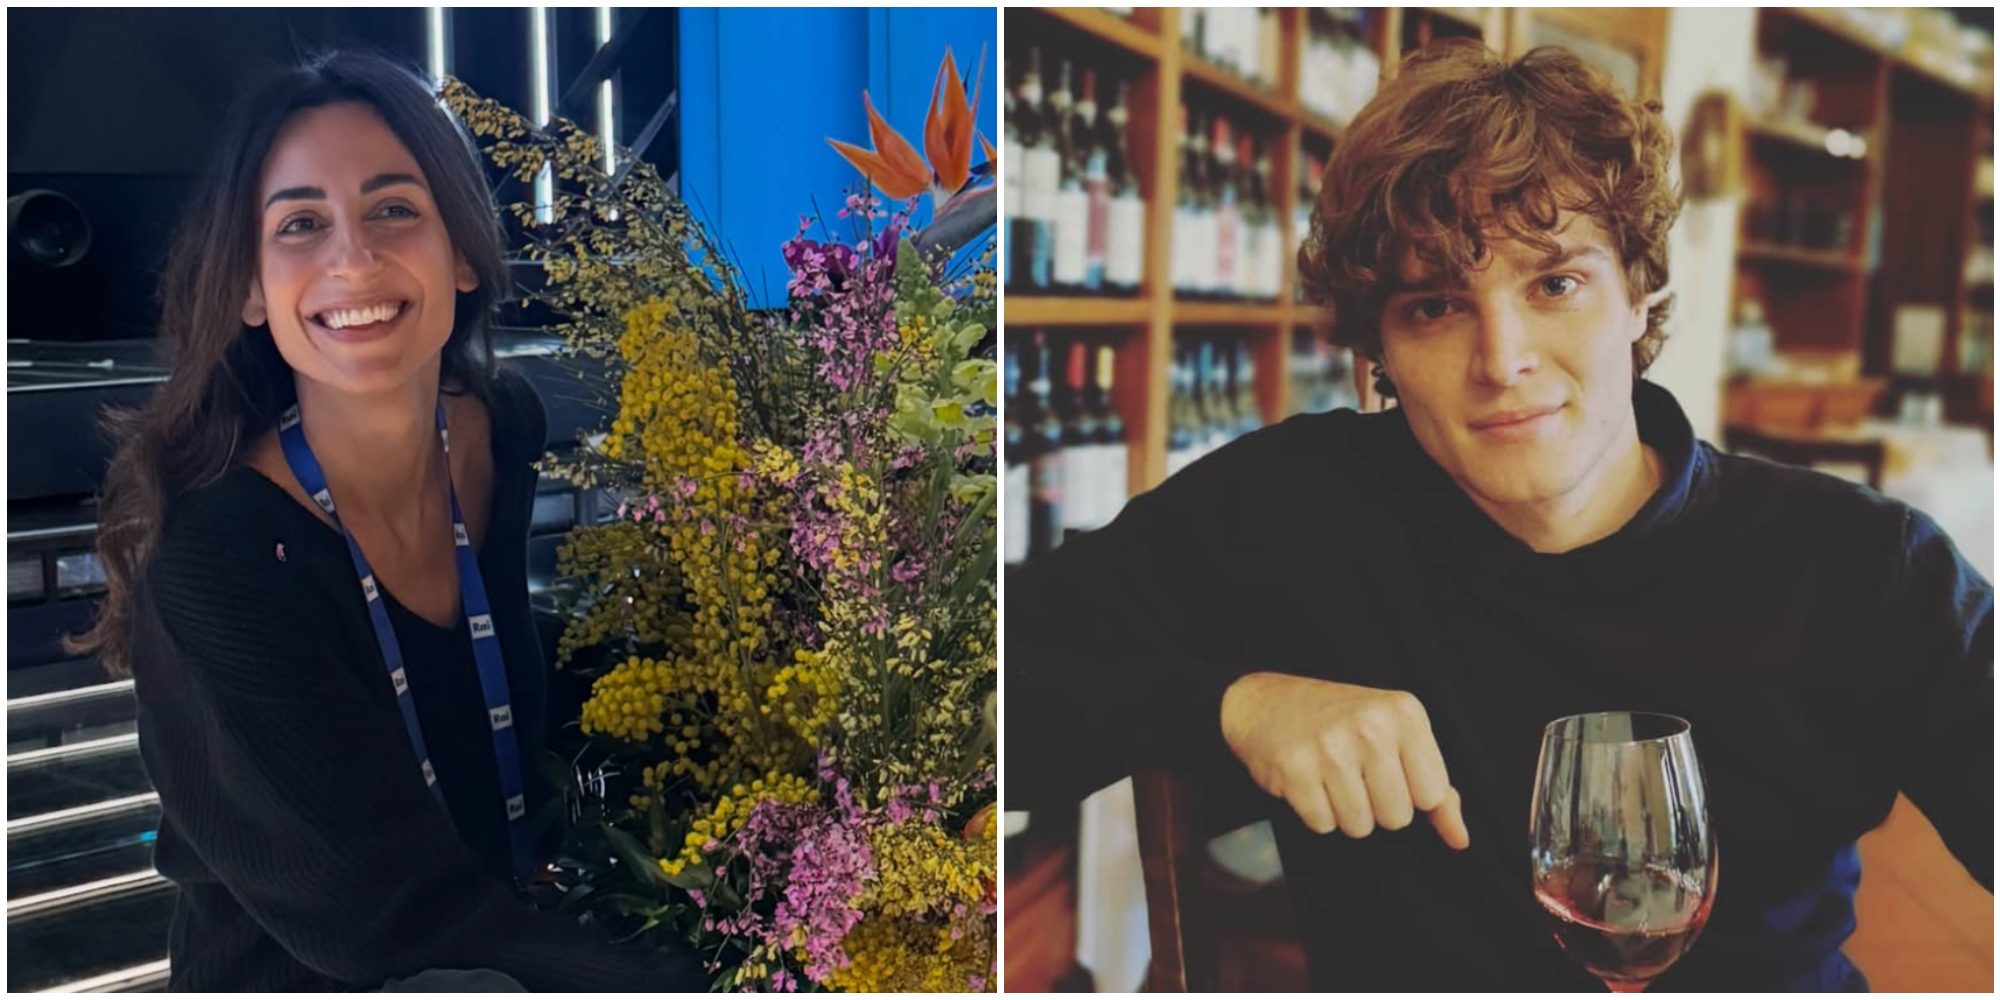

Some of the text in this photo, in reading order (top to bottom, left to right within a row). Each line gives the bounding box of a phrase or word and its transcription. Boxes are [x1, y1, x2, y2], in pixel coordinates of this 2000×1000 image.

[472, 619, 491, 633] Rai
[492, 709, 509, 724] Rai
[509, 799, 523, 814] Rai
